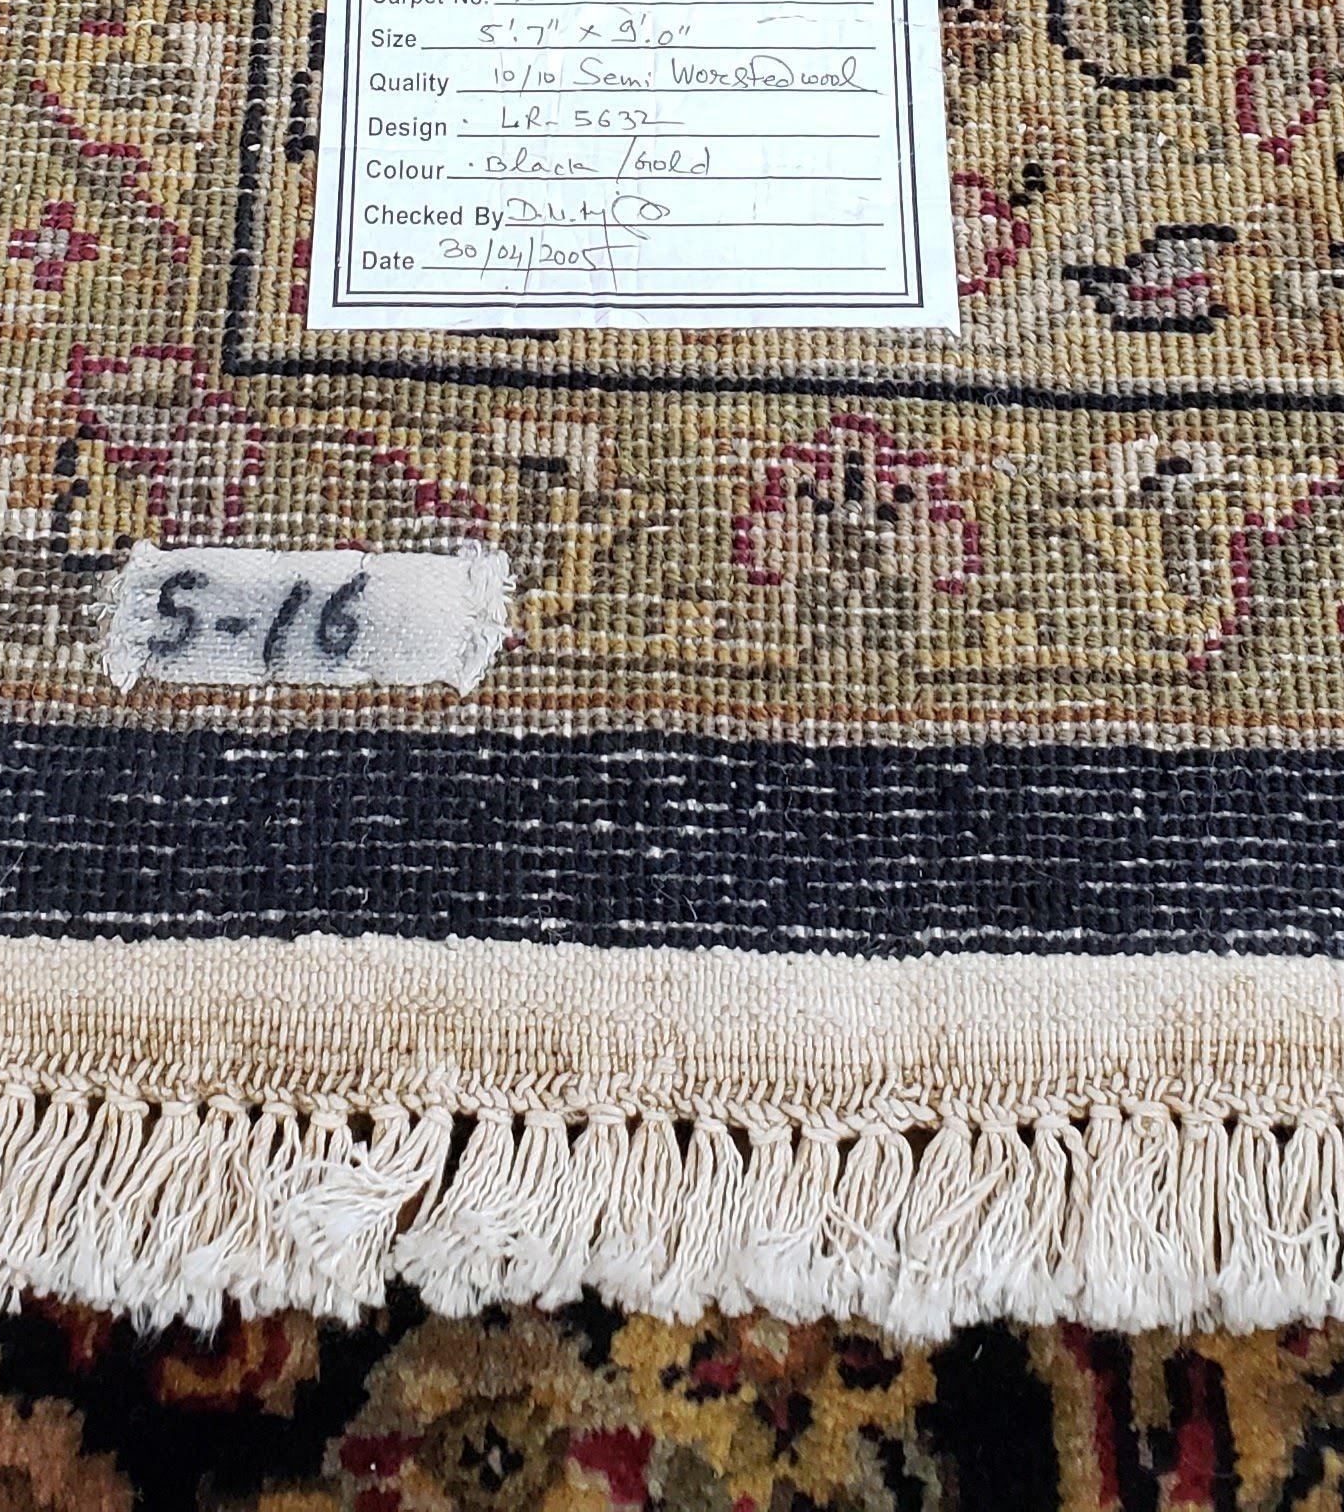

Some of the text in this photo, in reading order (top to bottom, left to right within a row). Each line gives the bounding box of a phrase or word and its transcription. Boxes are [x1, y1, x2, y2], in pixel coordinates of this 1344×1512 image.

[370, 28, 417, 49] Size
[369, 72, 450, 97] Quality
[494, 64, 556, 97] 10/10
[572, 56, 652, 89] Semi
[368, 116, 448, 141] Design
[574, 108, 685, 131] 5632
[366, 159, 445, 180] Colour
[364, 204, 464, 226] Checked
[474, 205, 504, 231] By
[361, 250, 415, 270] Date
[146, 569, 373, 668] S-16
